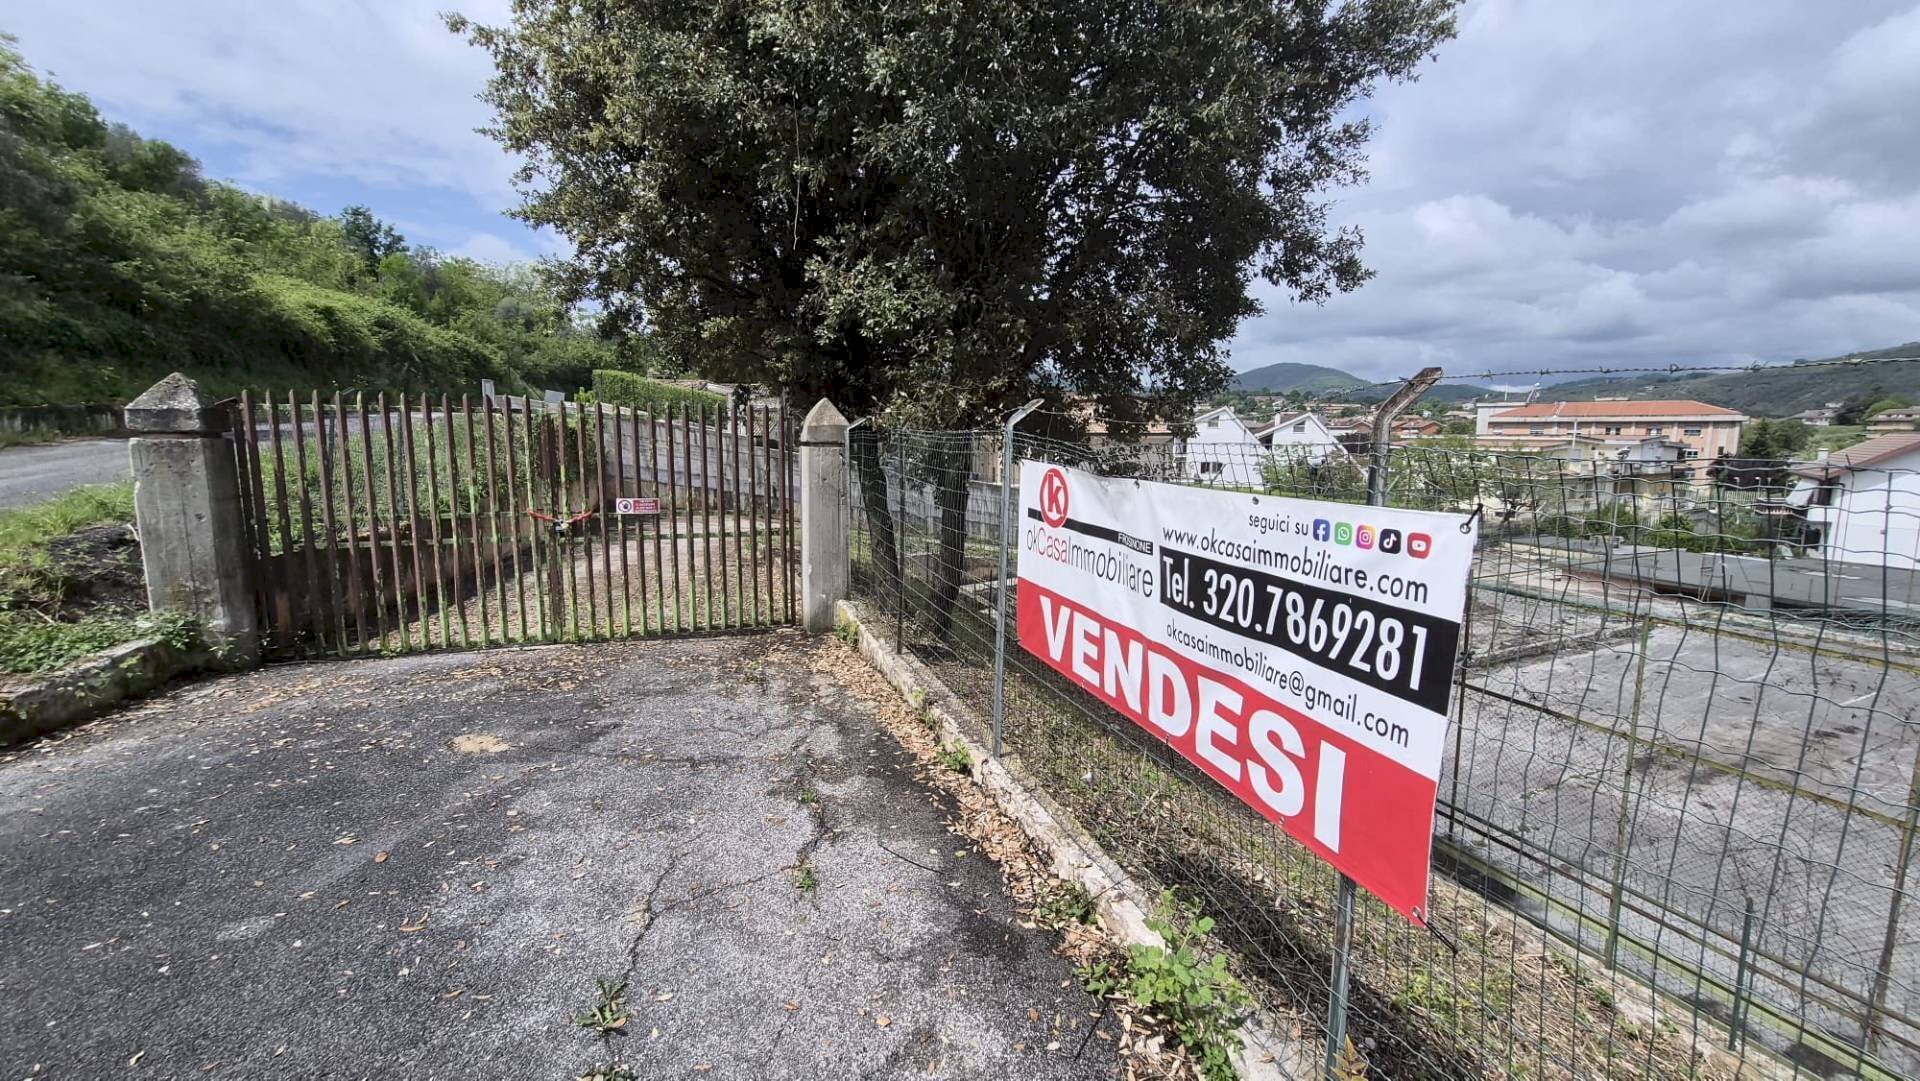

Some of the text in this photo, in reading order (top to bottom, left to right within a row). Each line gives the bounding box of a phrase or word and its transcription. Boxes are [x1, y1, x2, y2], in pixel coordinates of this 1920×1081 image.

[1026, 524, 1154, 598] okCasaImmobiliare
[1162, 527, 1429, 605] www.okcasaimmobiliare.com
[1248, 513, 1309, 537] seguici su
[1162, 555, 1428, 692] Tel. 320.7869281
[1039, 594, 1347, 855] VENDESI
[1166, 619, 1410, 748] okcasaimmobiliare@gmail.com
